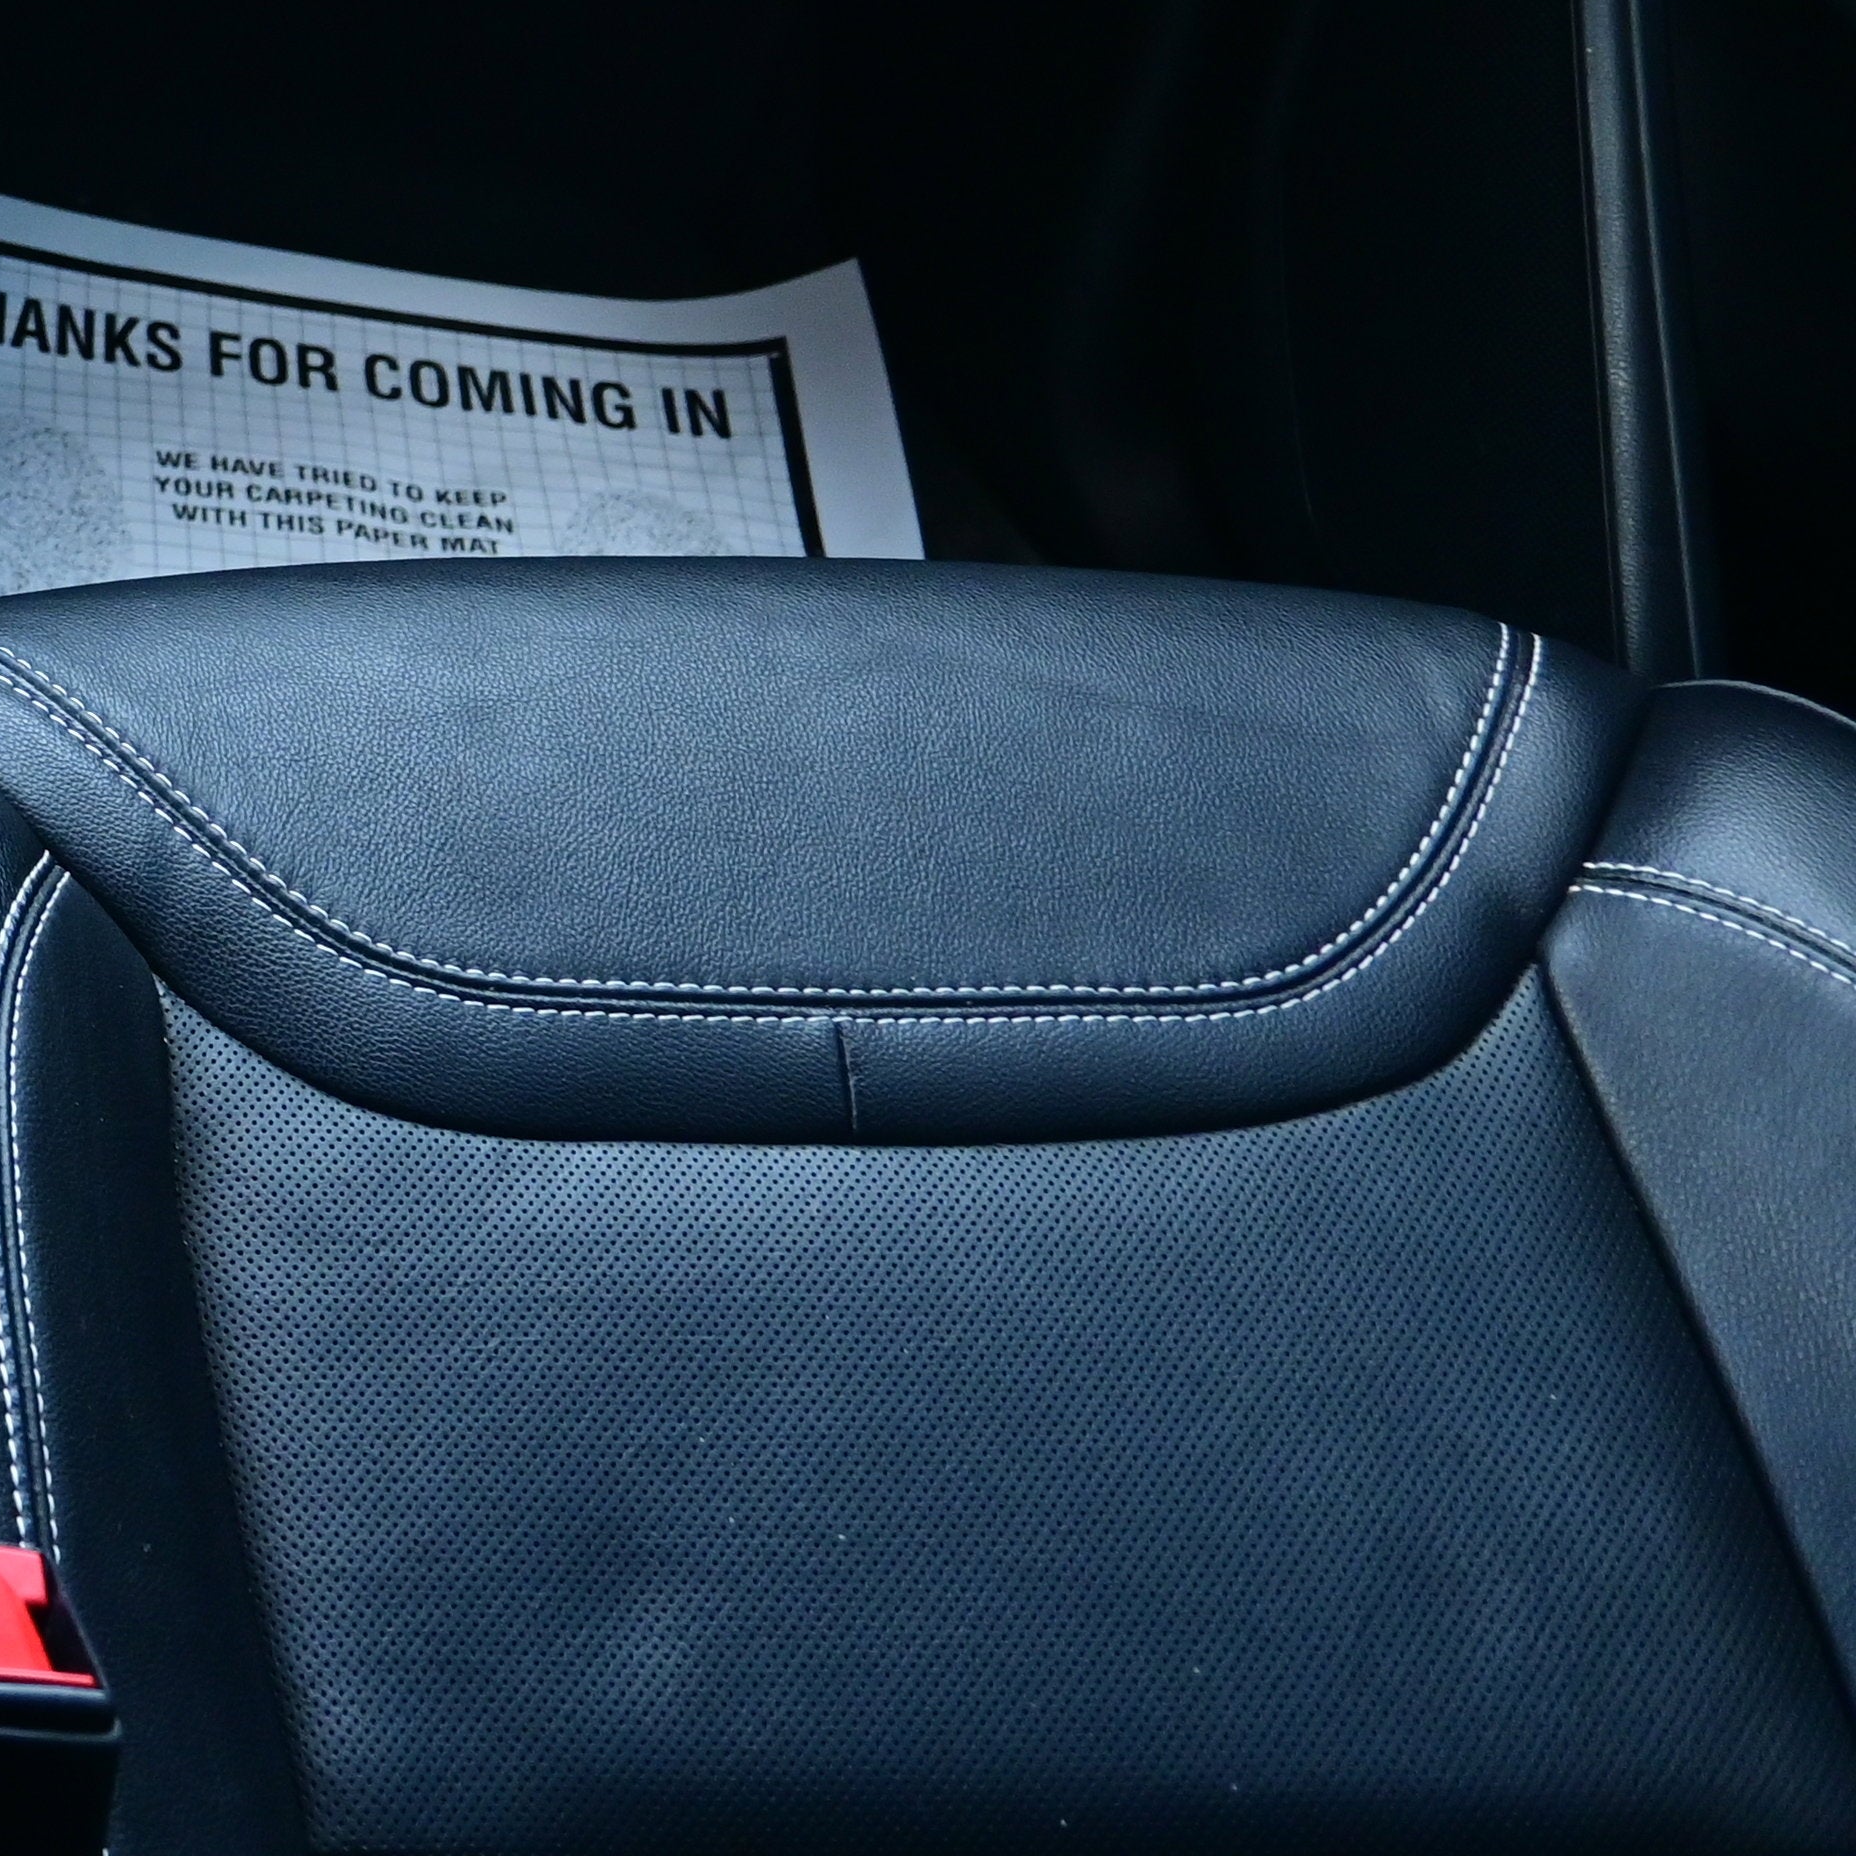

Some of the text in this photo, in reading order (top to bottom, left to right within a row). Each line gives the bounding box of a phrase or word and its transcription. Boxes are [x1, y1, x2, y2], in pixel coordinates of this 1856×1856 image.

[208, 330, 339, 392] FOR
[363, 353, 637, 431] COMING
[661, 386, 732, 440] IN
[154, 475, 514, 535] YOUR CARPETING CLEAN
[156, 449, 508, 508] WE HAVE TRIED TO KEEP
[172, 502, 502, 556] WITH THIS PAPER MAT
